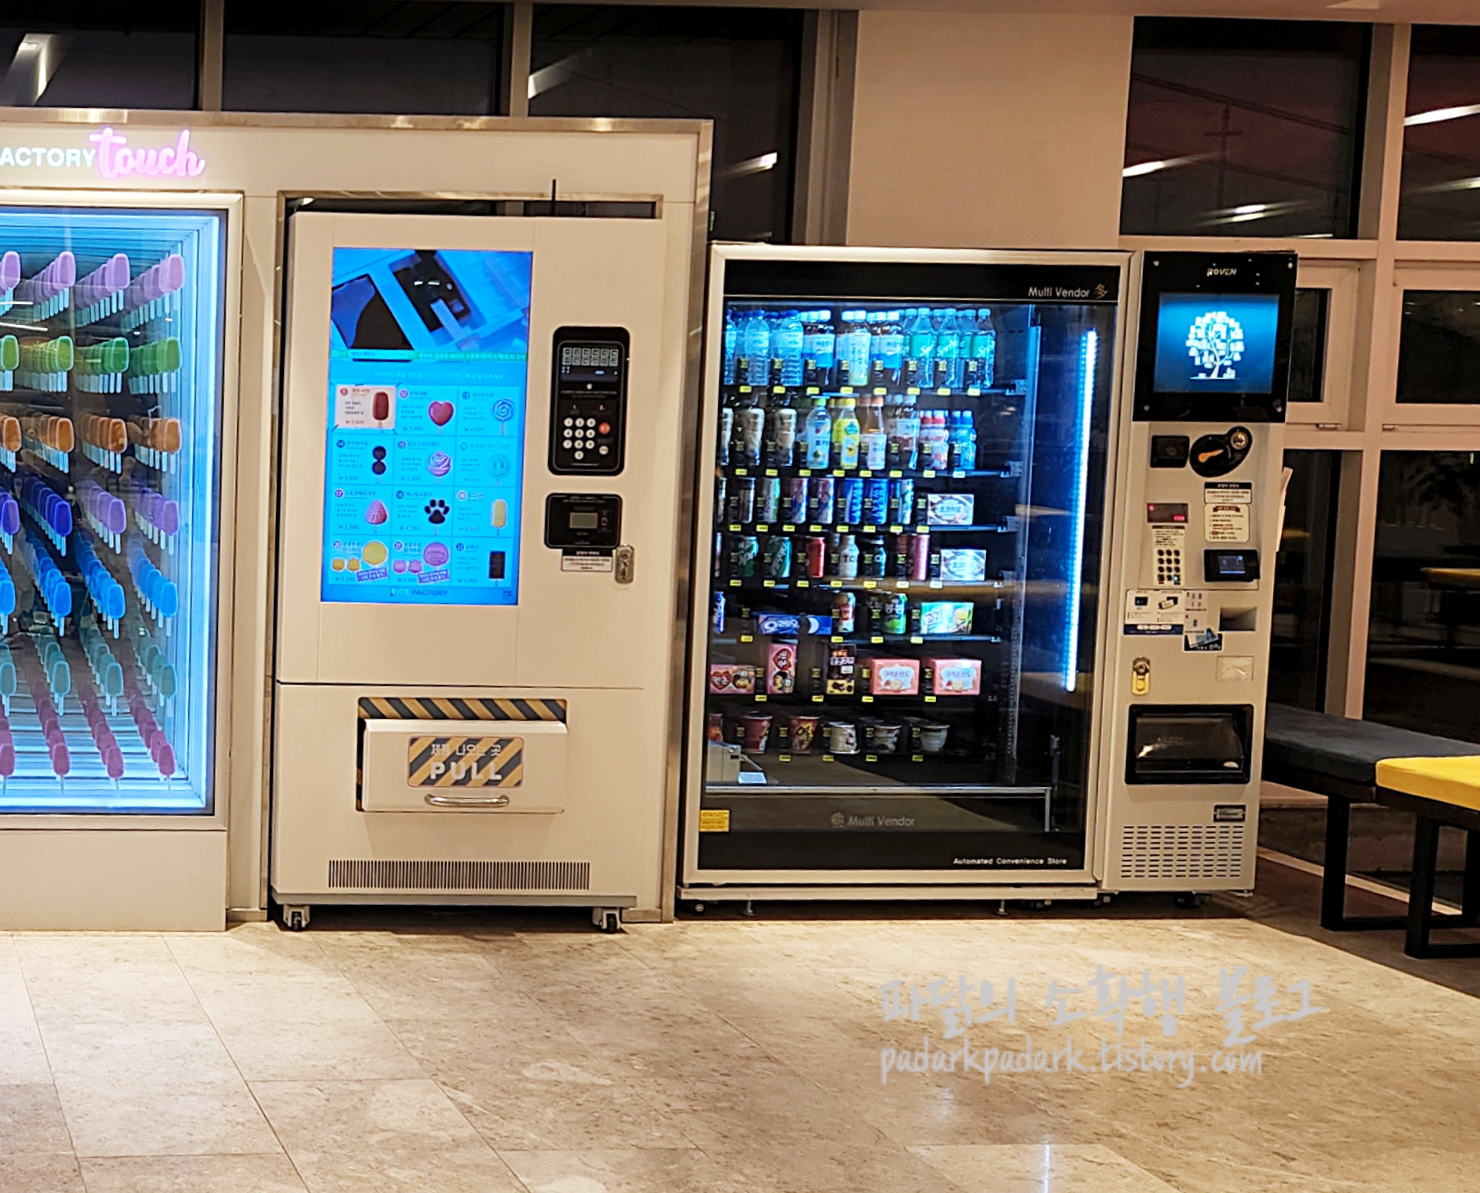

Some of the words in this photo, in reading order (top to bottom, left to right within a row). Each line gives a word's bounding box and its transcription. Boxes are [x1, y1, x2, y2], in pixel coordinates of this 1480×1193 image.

[88, 127, 205, 178] touch
[1028, 287, 1053, 298] Multi
[1055, 287, 1091, 298] Vendor
[456, 744, 486, 756] 나오는
[490, 744, 501, 757] 곳
[430, 761, 503, 780] PULL
[848, 816, 874, 826] Multi
[877, 816, 915, 826] Vendor
[953, 857, 994, 865] Automated
[996, 857, 1044, 865] Convenience
[1047, 857, 1068, 865] Store
